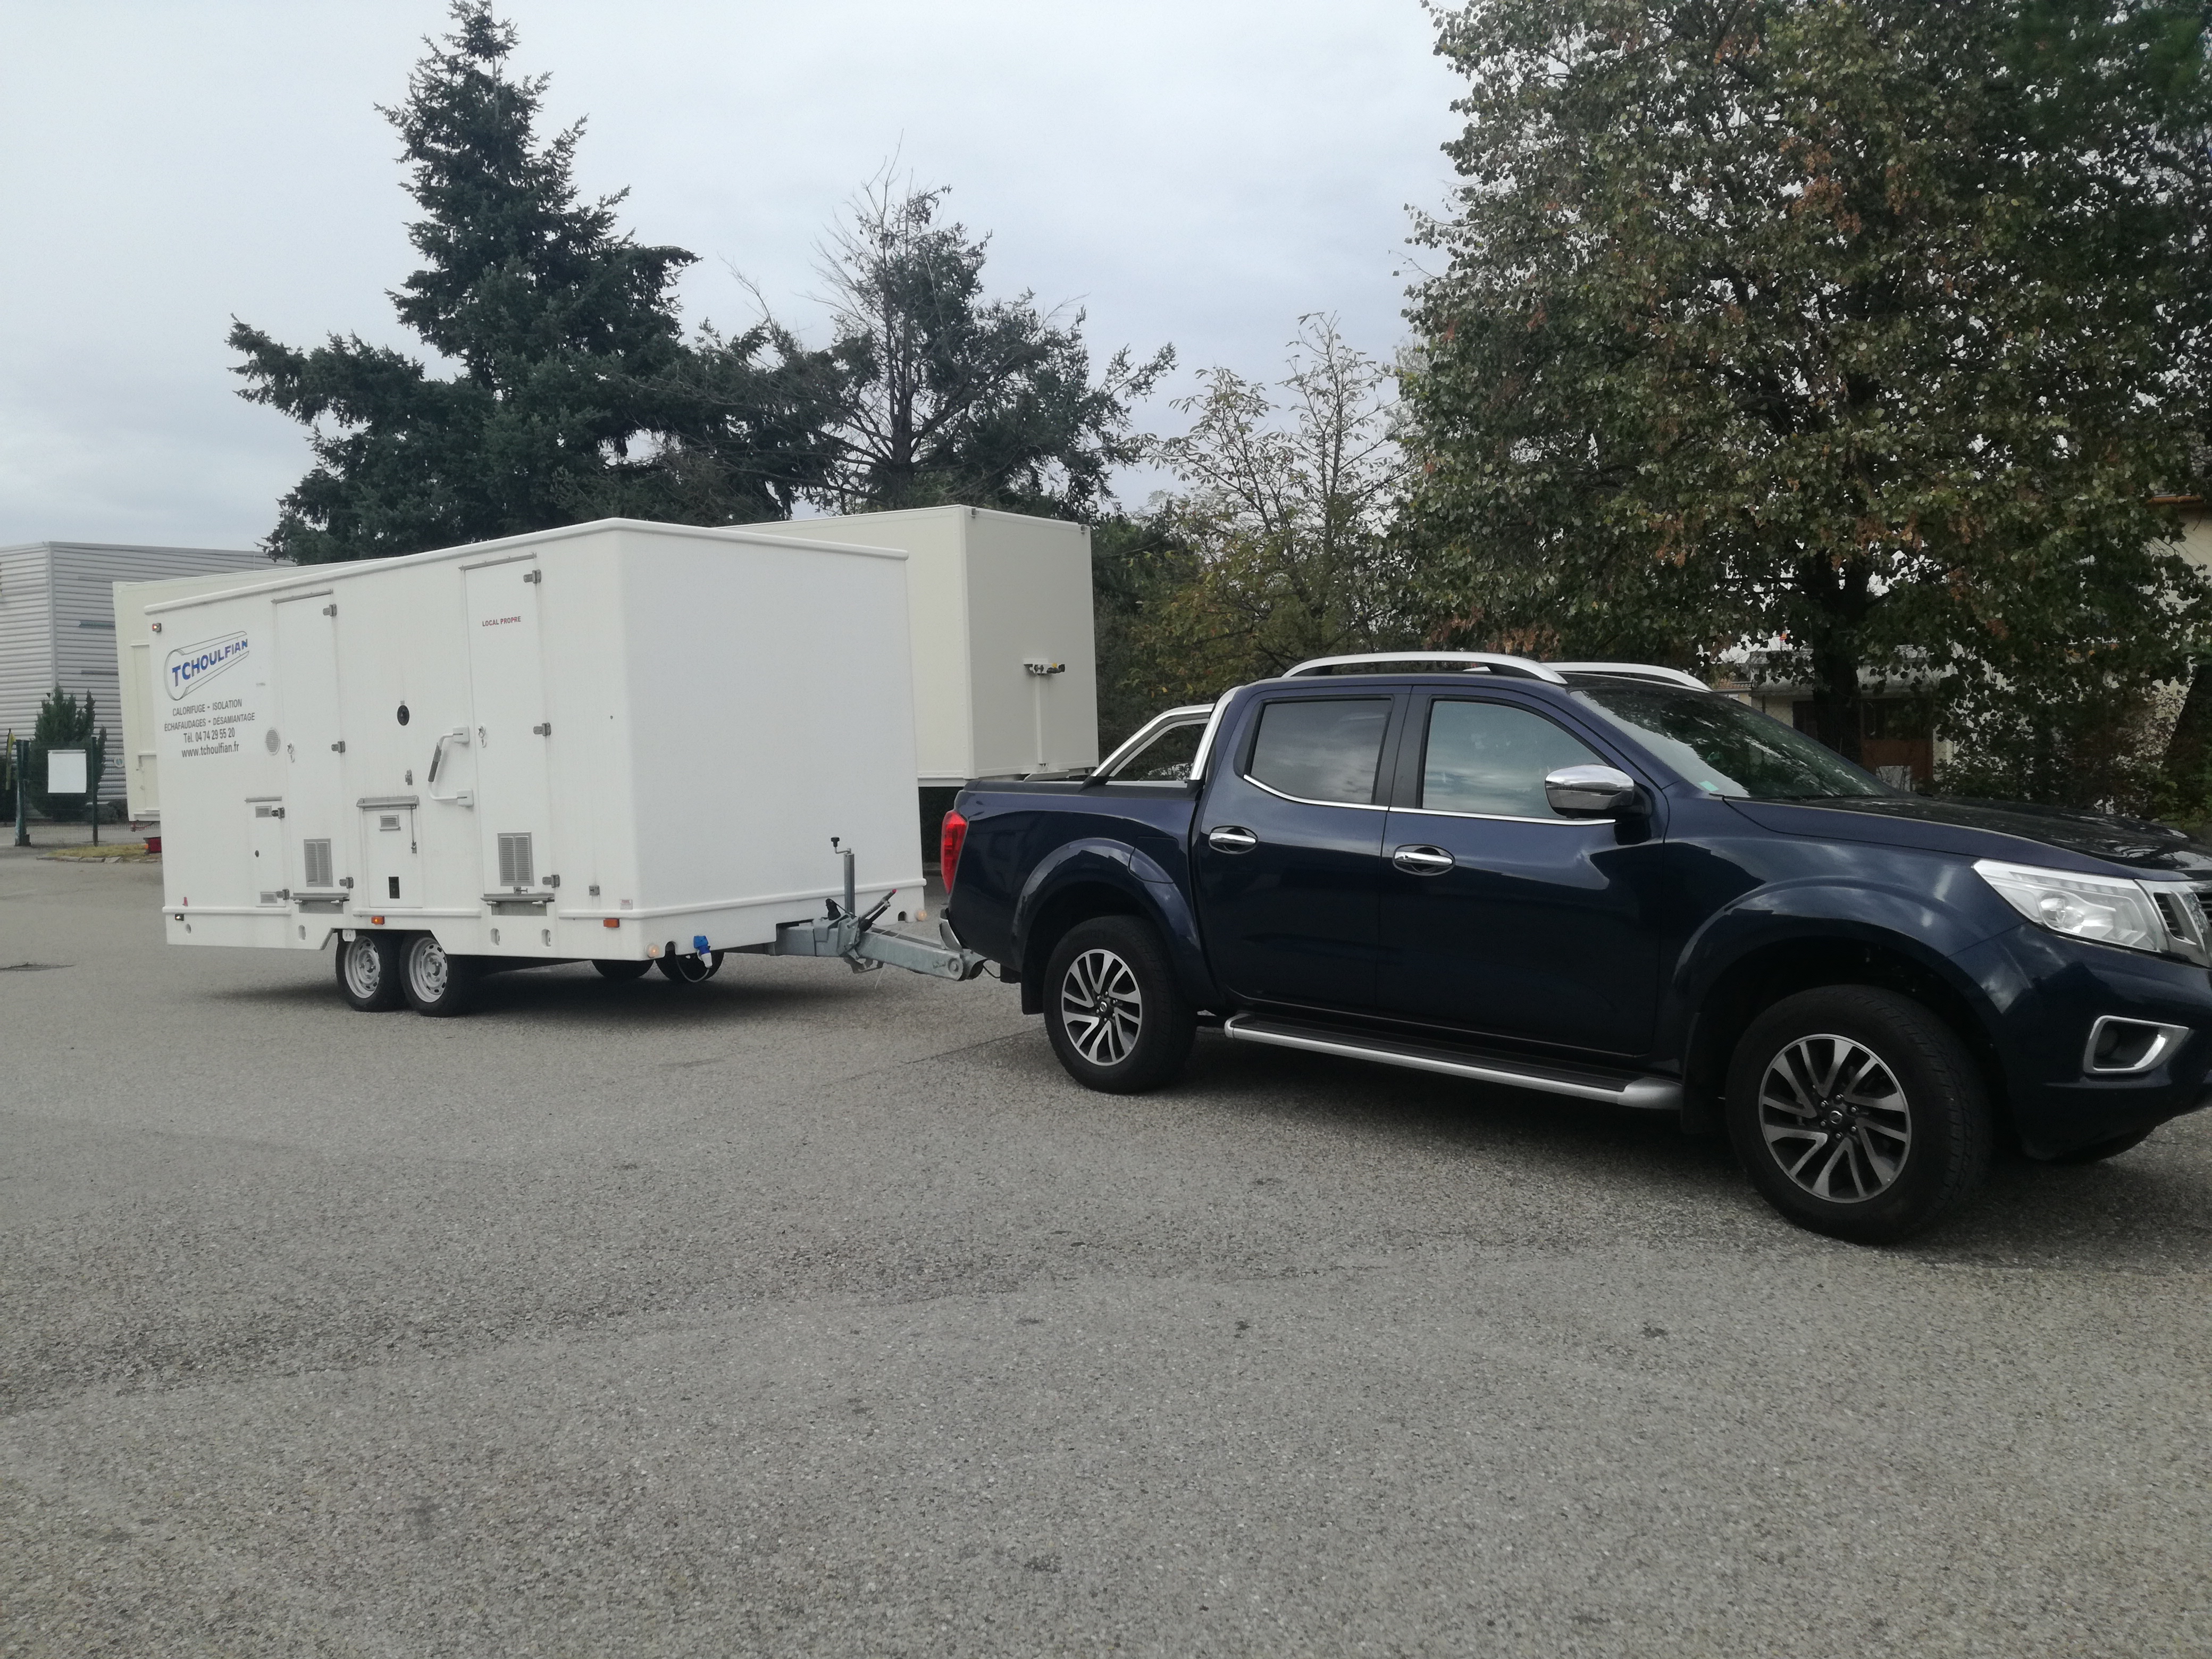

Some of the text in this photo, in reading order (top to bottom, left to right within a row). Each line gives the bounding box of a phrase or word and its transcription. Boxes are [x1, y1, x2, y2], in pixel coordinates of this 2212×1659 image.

[500, 616, 521, 624] PROPRE
[172, 639, 248, 687] TCHOULFIAN
[172, 703, 205, 716] CALORIFUGE
[212, 699, 242, 710] ISOLATION
[213, 713, 255, 725] DÉSAMIANTAGE
[183, 727, 235, 743] Tél. 04 74 29 55 20
[182, 741, 239, 757] www.tchoulfian.fr
